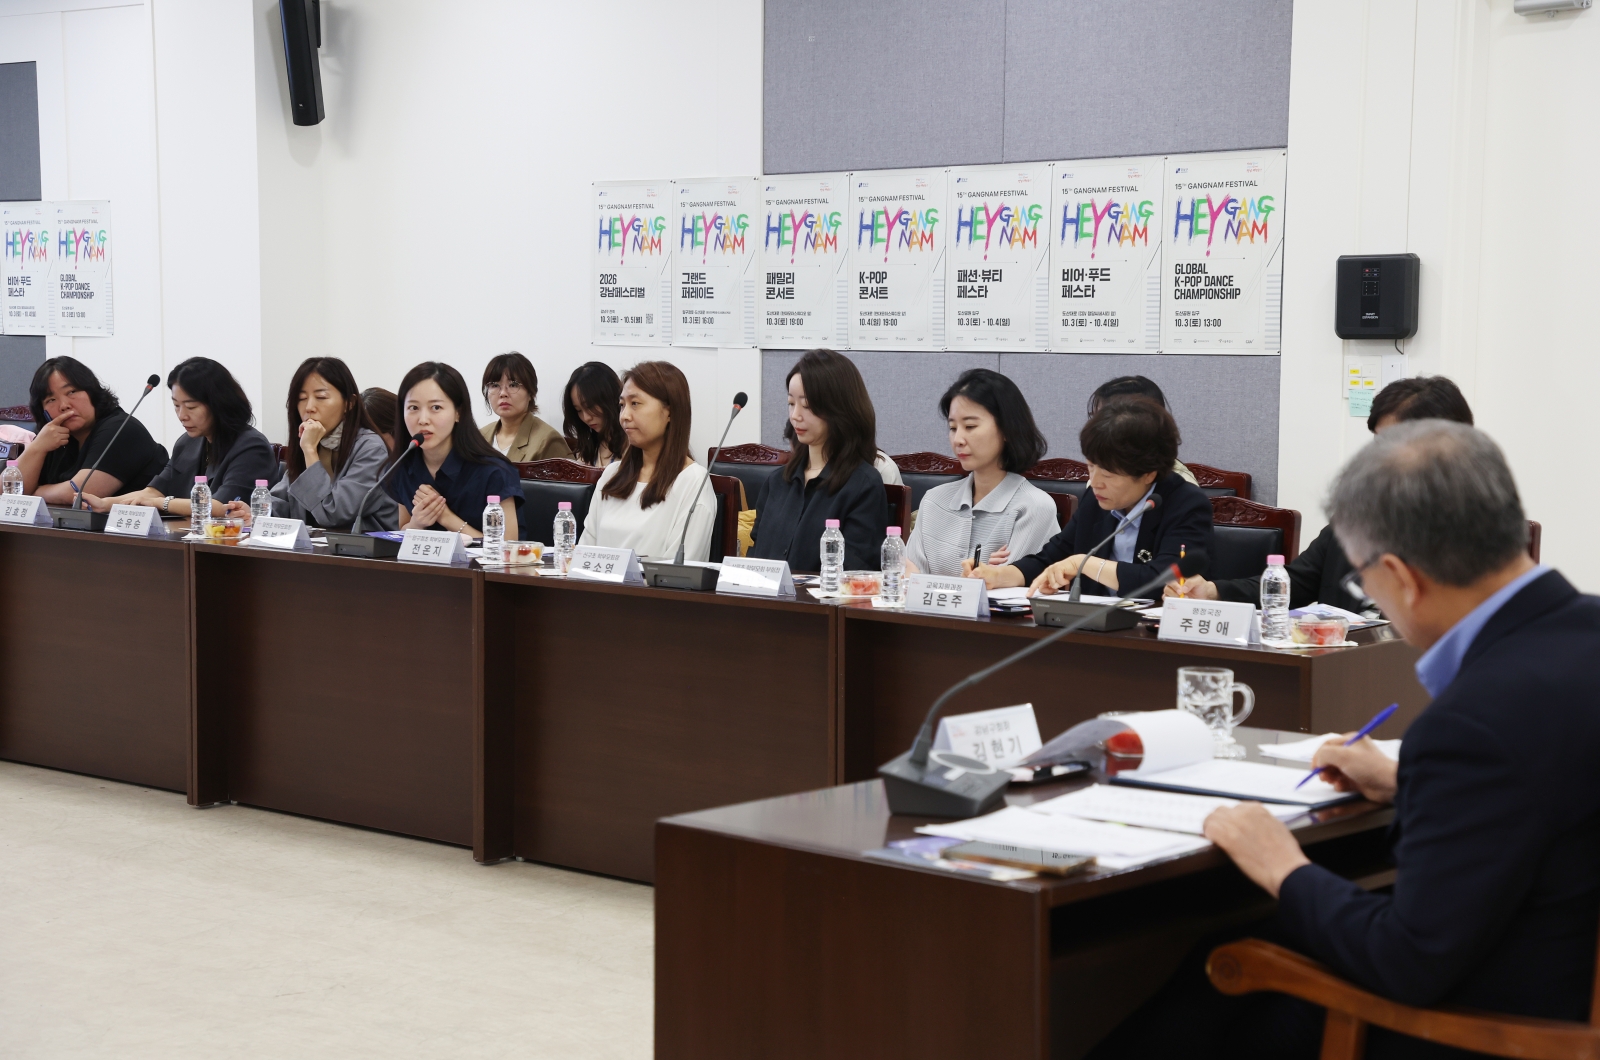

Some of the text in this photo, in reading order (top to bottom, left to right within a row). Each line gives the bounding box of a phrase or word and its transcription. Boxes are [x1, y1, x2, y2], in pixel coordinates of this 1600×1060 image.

[1108, 200, 1154, 226] GANG
[1225, 195, 1275, 222] GANG
[804, 211, 842, 235] GANG
[898, 208, 939, 233] GANG
[999, 204, 1043, 230] GANG
[632, 216, 666, 238] GANG
[714, 214, 749, 237] GANG
[1224, 218, 1268, 245] NAM
[898, 228, 934, 252] NAM
[999, 226, 1037, 251] NAM
[1108, 222, 1148, 248] NAM
[632, 234, 662, 256] NAM
[714, 233, 745, 255] NAM
[804, 231, 837, 254] NAM
[1062, 268, 1110, 282] 비어·푸드
[1175, 263, 1208, 274] GLOBAL
[60, 274, 77, 282] GLOBAL
[600, 274, 617, 284] 2026
[682, 273, 706, 284] 그랜드
[766, 272, 794, 284] 패밀리
[859, 271, 888, 284] K-POP
[957, 269, 1002, 282] 패션·뷰티
[1175, 276, 1233, 287] K-POP DANCE
[60, 282, 90, 290] K-POP DANCE
[600, 287, 645, 298] 강남페스티벌
[859, 286, 888, 299] 콘서트
[957, 285, 988, 298] 페스타
[1062, 284, 1095, 298] 페스타
[61, 291, 94, 299] CHAMPIONSHIP
[682, 287, 714, 299] 퍼레이드
[766, 287, 794, 300] 콘서트
[1174, 288, 1241, 300] CHAMPIONSHIP
[1204, 318, 1221, 327] 13:00
[926, 582, 962, 591] 교육지원과장
[923, 592, 962, 608] 김은주
[1193, 607, 1222, 617] 행정국장
[1180, 618, 1229, 636] 주명애
